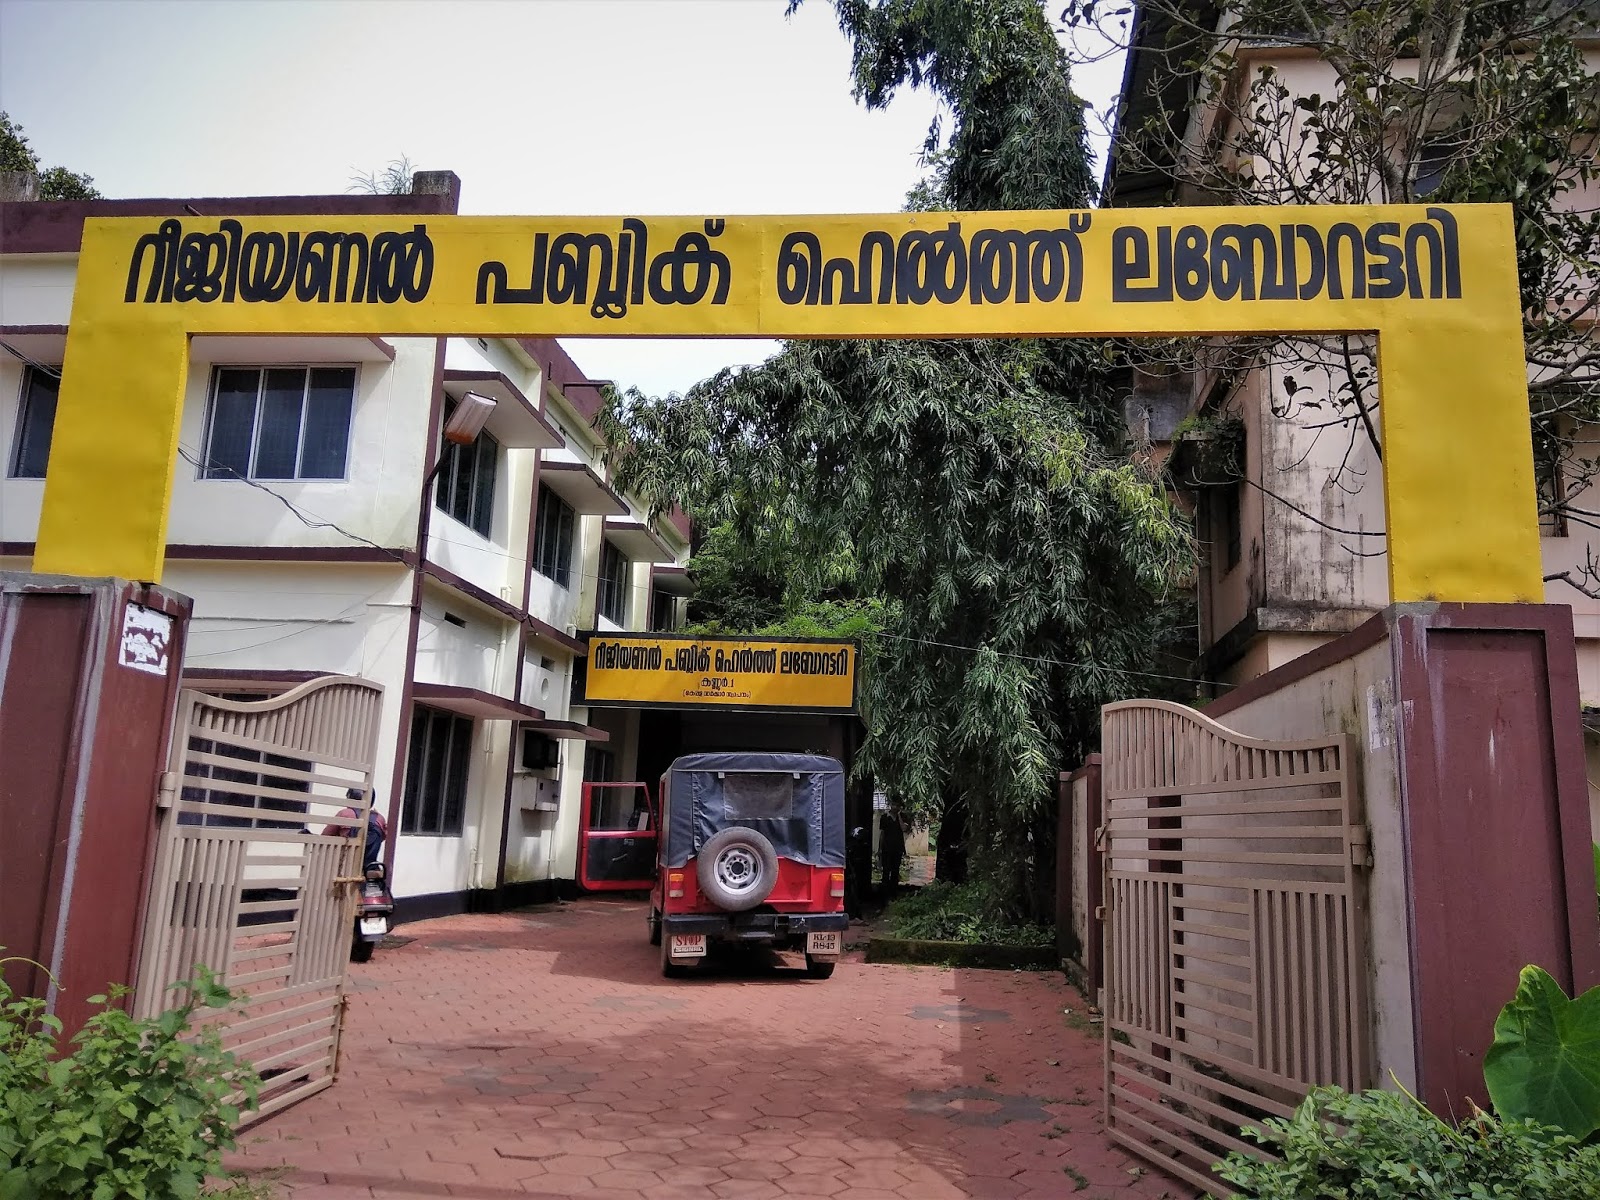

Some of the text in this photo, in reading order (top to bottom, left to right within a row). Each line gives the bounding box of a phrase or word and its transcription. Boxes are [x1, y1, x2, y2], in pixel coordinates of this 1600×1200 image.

[124, 206, 1462, 318] റീജിയണൽ പബ്ലിക് ഹെൽത്ത് ലബോറട്ടറി
[665, 645, 711, 674] പബ്ലിക്
[715, 648, 777, 674] ഹെൽത്ത്
[780, 648, 849, 676] ലബോറട്ടറി
[676, 934, 702, 946] STOP
